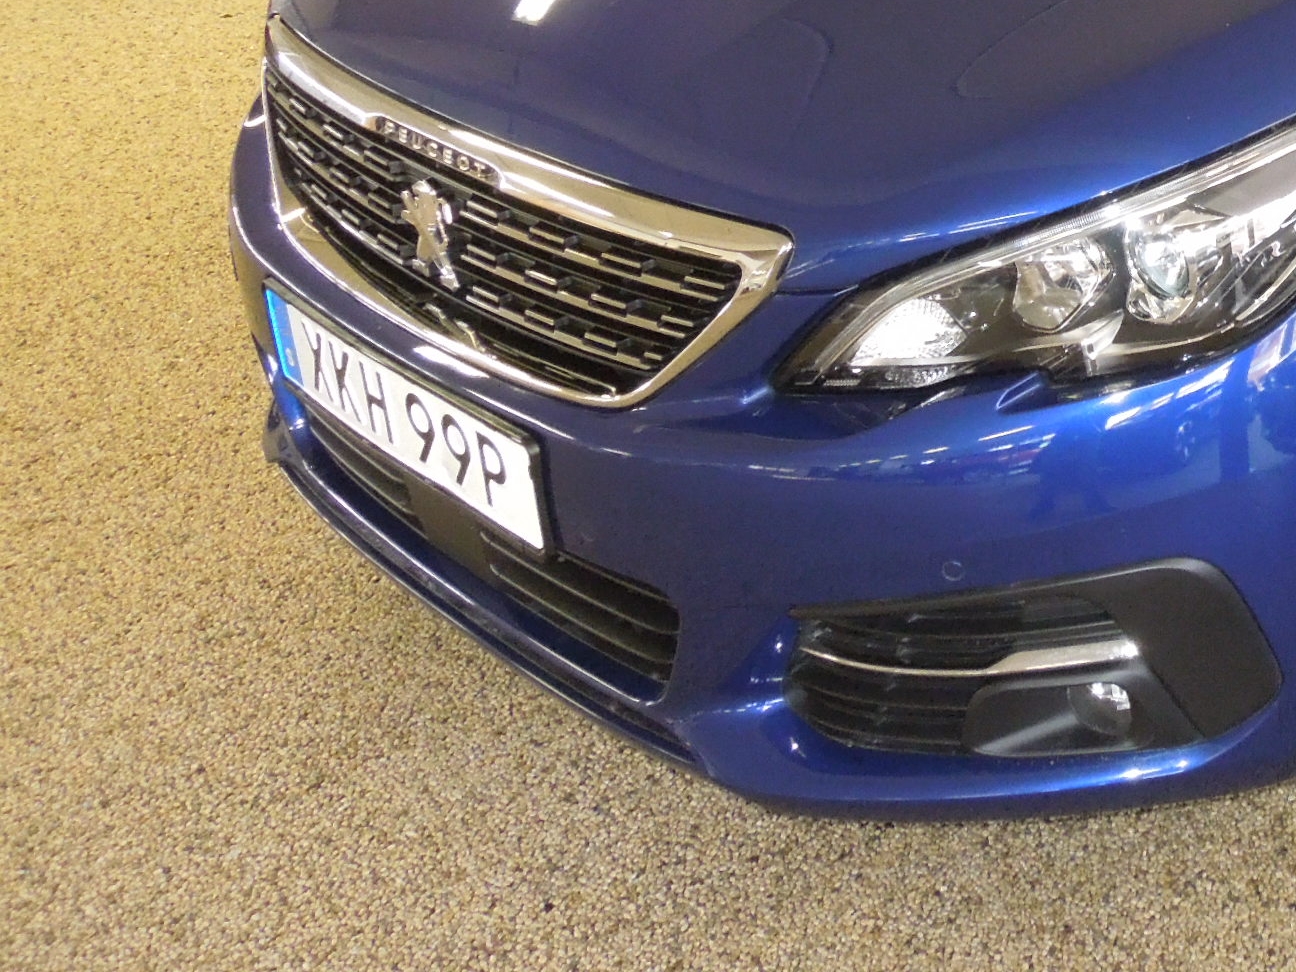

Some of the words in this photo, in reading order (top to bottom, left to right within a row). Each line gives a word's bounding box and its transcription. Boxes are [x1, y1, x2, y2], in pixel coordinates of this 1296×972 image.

[384, 120, 486, 178] PEUGEOT
[301, 318, 394, 445] XKH
[405, 392, 507, 508] 99P
